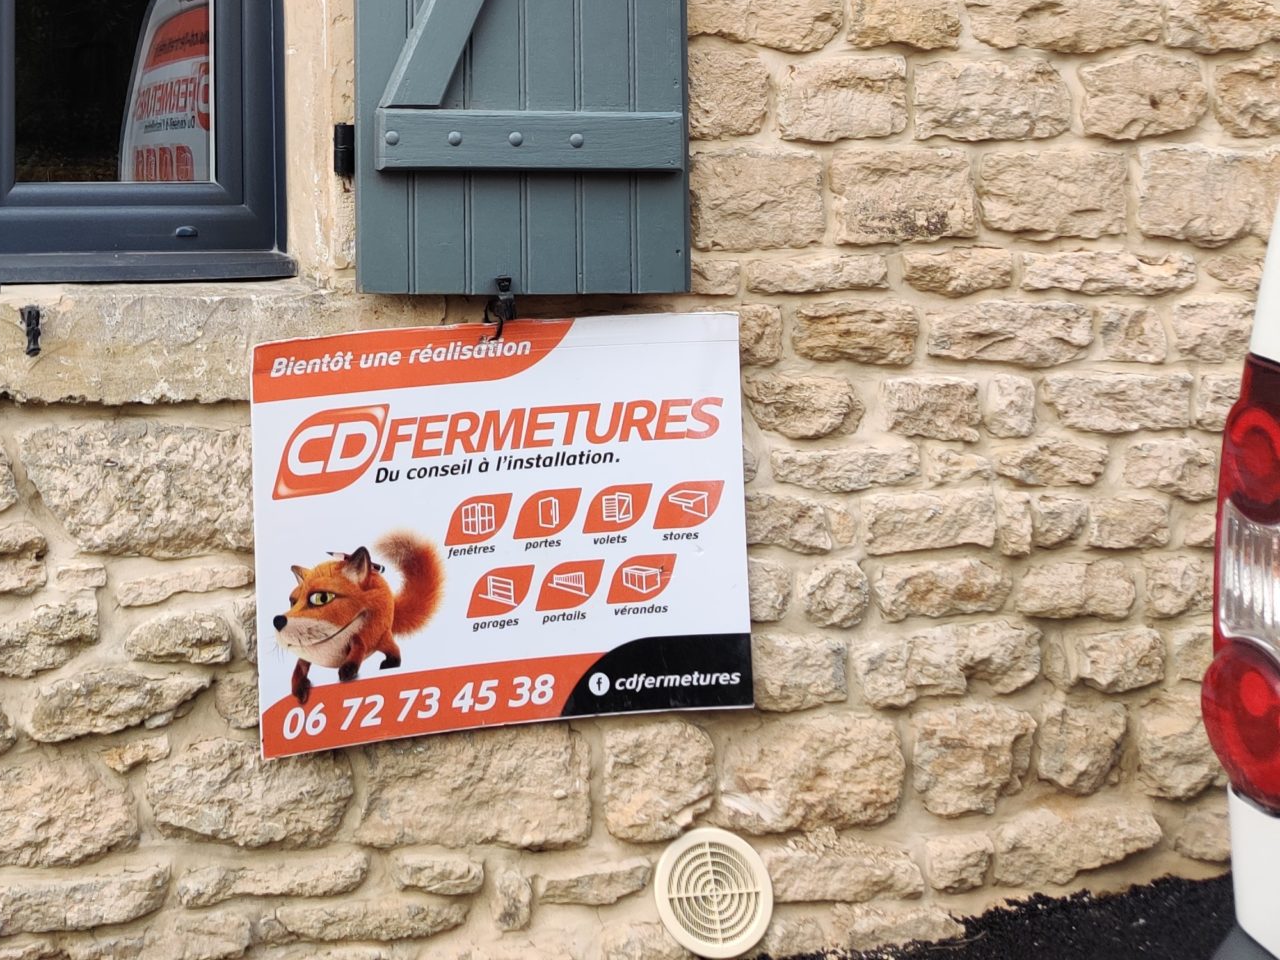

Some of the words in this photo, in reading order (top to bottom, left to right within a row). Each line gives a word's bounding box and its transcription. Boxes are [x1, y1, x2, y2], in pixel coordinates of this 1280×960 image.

[270, 351, 353, 378] Bientôt
[359, 349, 401, 369] une
[408, 338, 531, 364] réalisation
[379, 396, 724, 462] FERMETURES
[375, 467, 400, 483] Du
[406, 459, 473, 480] conseil
[478, 457, 489, 473] à
[593, 534, 627, 545] volets
[662, 530, 699, 541] stores
[524, 539, 561, 551] portes
[542, 610, 586, 624] portails
[614, 603, 668, 616] vérandas
[472, 617, 519, 632] garages
[615, 671, 741, 693] cdfermetures
[282, 702, 327, 740] 06
[340, 694, 385, 731] 72
[396, 686, 441, 722] 73
[452, 679, 499, 713] 45
[508, 673, 555, 708] 38
